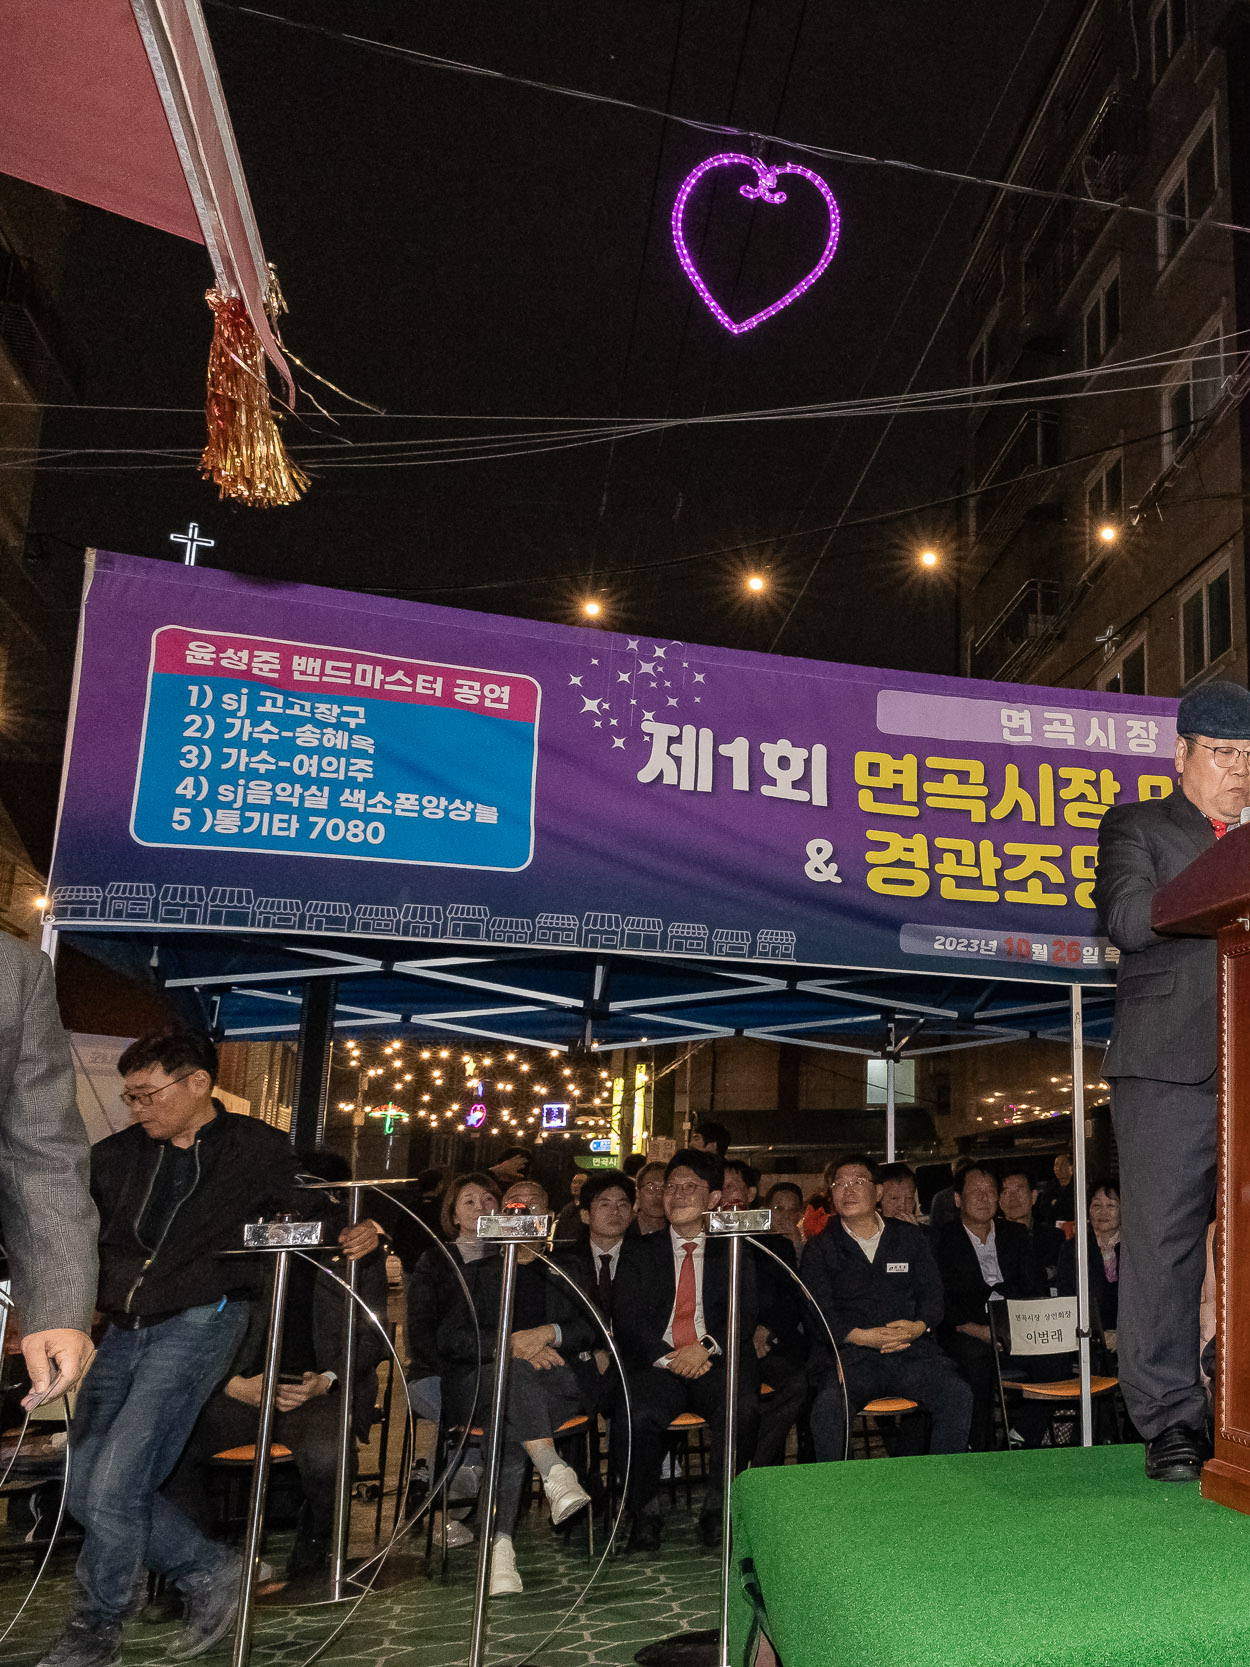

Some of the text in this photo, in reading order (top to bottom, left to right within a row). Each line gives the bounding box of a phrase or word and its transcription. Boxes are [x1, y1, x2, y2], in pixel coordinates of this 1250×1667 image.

[185, 641, 511, 710] 윤성준 밴드마스터 공연
[187, 685, 366, 729] 1) sj 고고장구
[182, 715, 376, 754] 2) 가수-송혜옥
[179, 745, 374, 782] 3) 가수-여의주
[637, 721, 829, 807] 제1회
[854, 750, 1121, 827] 면곡시장
[175, 776, 209, 801] 4)
[217, 779, 330, 809] sj음악실
[171, 807, 192, 831] 5
[308, 816, 386, 845] 7080
[804, 838, 843, 884] &
[933, 935, 998, 956] 2023년
[1003, 936, 1048, 962] 10월
[1051, 939, 1099, 965] 26일
[1026, 1329, 1063, 1344] 이범래
